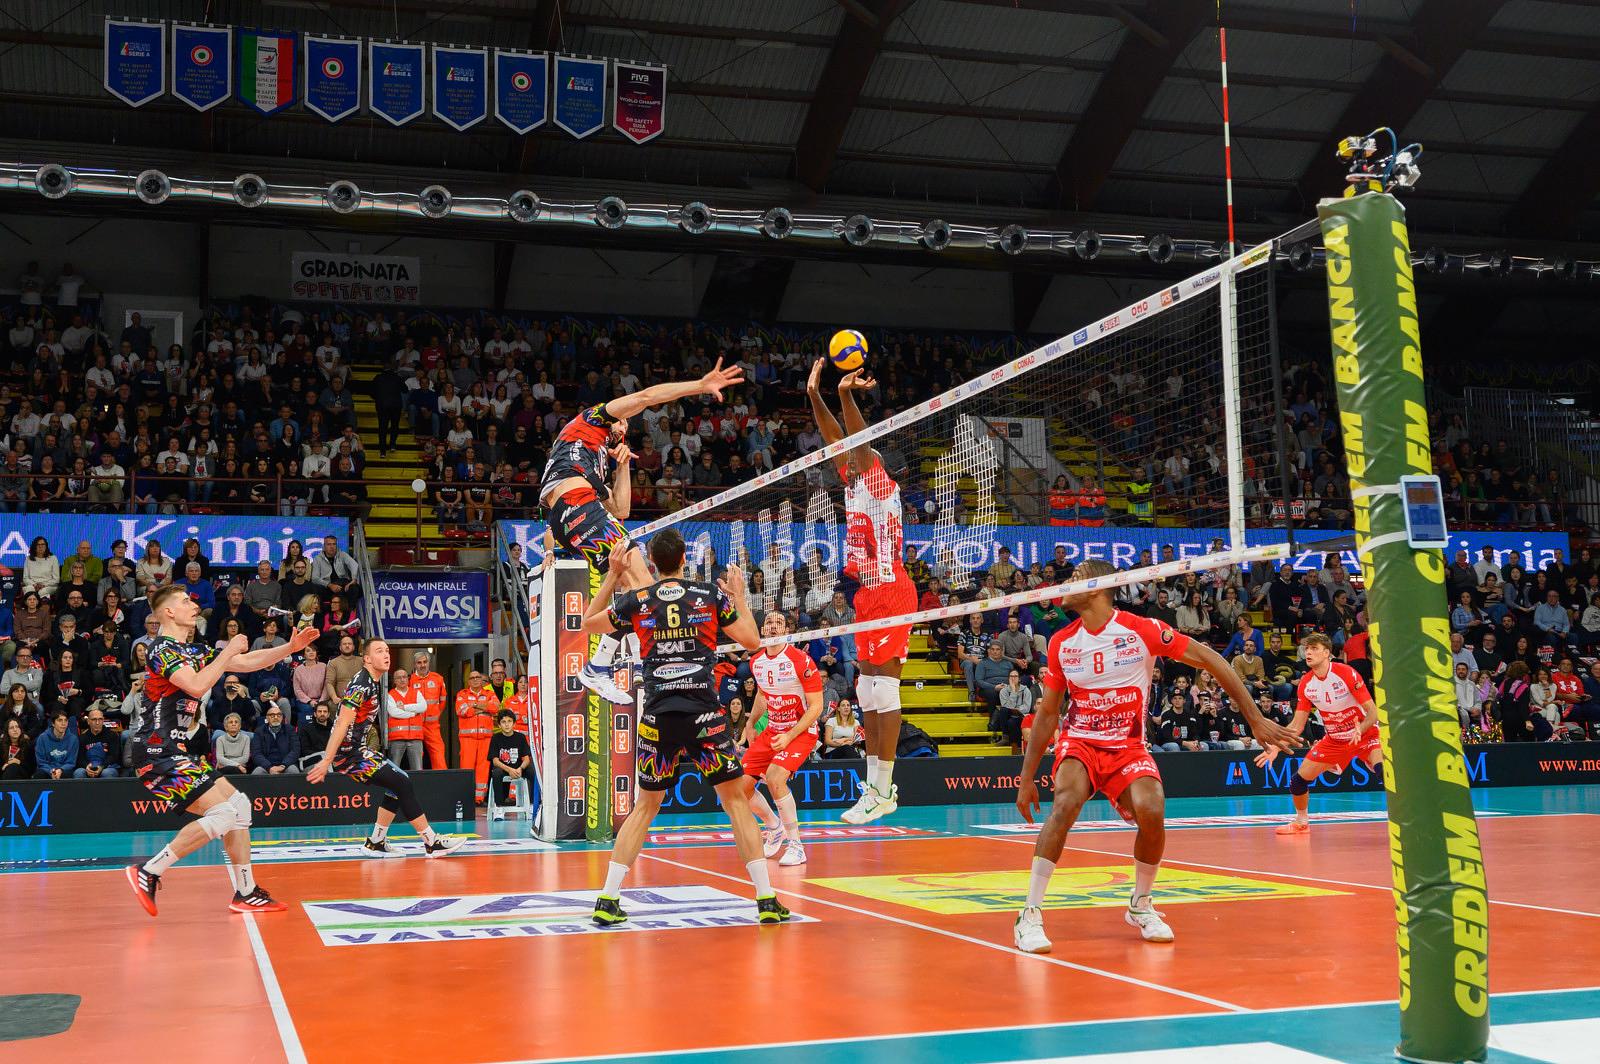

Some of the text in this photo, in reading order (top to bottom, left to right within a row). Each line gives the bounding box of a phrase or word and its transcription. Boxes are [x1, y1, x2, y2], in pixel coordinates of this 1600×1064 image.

[1325, 223, 1360, 386] BANCA
[1391, 221, 1425, 382] BANCA
[378, 582, 467, 591] ACQUA MINERALE
[658, 589, 683, 597] MONINI
[666, 603, 681, 629] 6
[653, 626, 698, 640] GIANNELLI
[1093, 651, 1105, 675] 8
[767, 670, 774, 685] 6
[1325, 691, 1332, 704] 4
[1420, 617, 1470, 789] BANCA
[588, 695, 600, 754] BANCA
[1111, 711, 1136, 719] SALES
[571, 717, 579, 736] PCS
[638, 738, 658, 753] Kimia
[571, 779, 579, 797] PCS
[587, 761, 600, 829] CREDEM
[1442, 812, 1489, 1019] CREDEM
